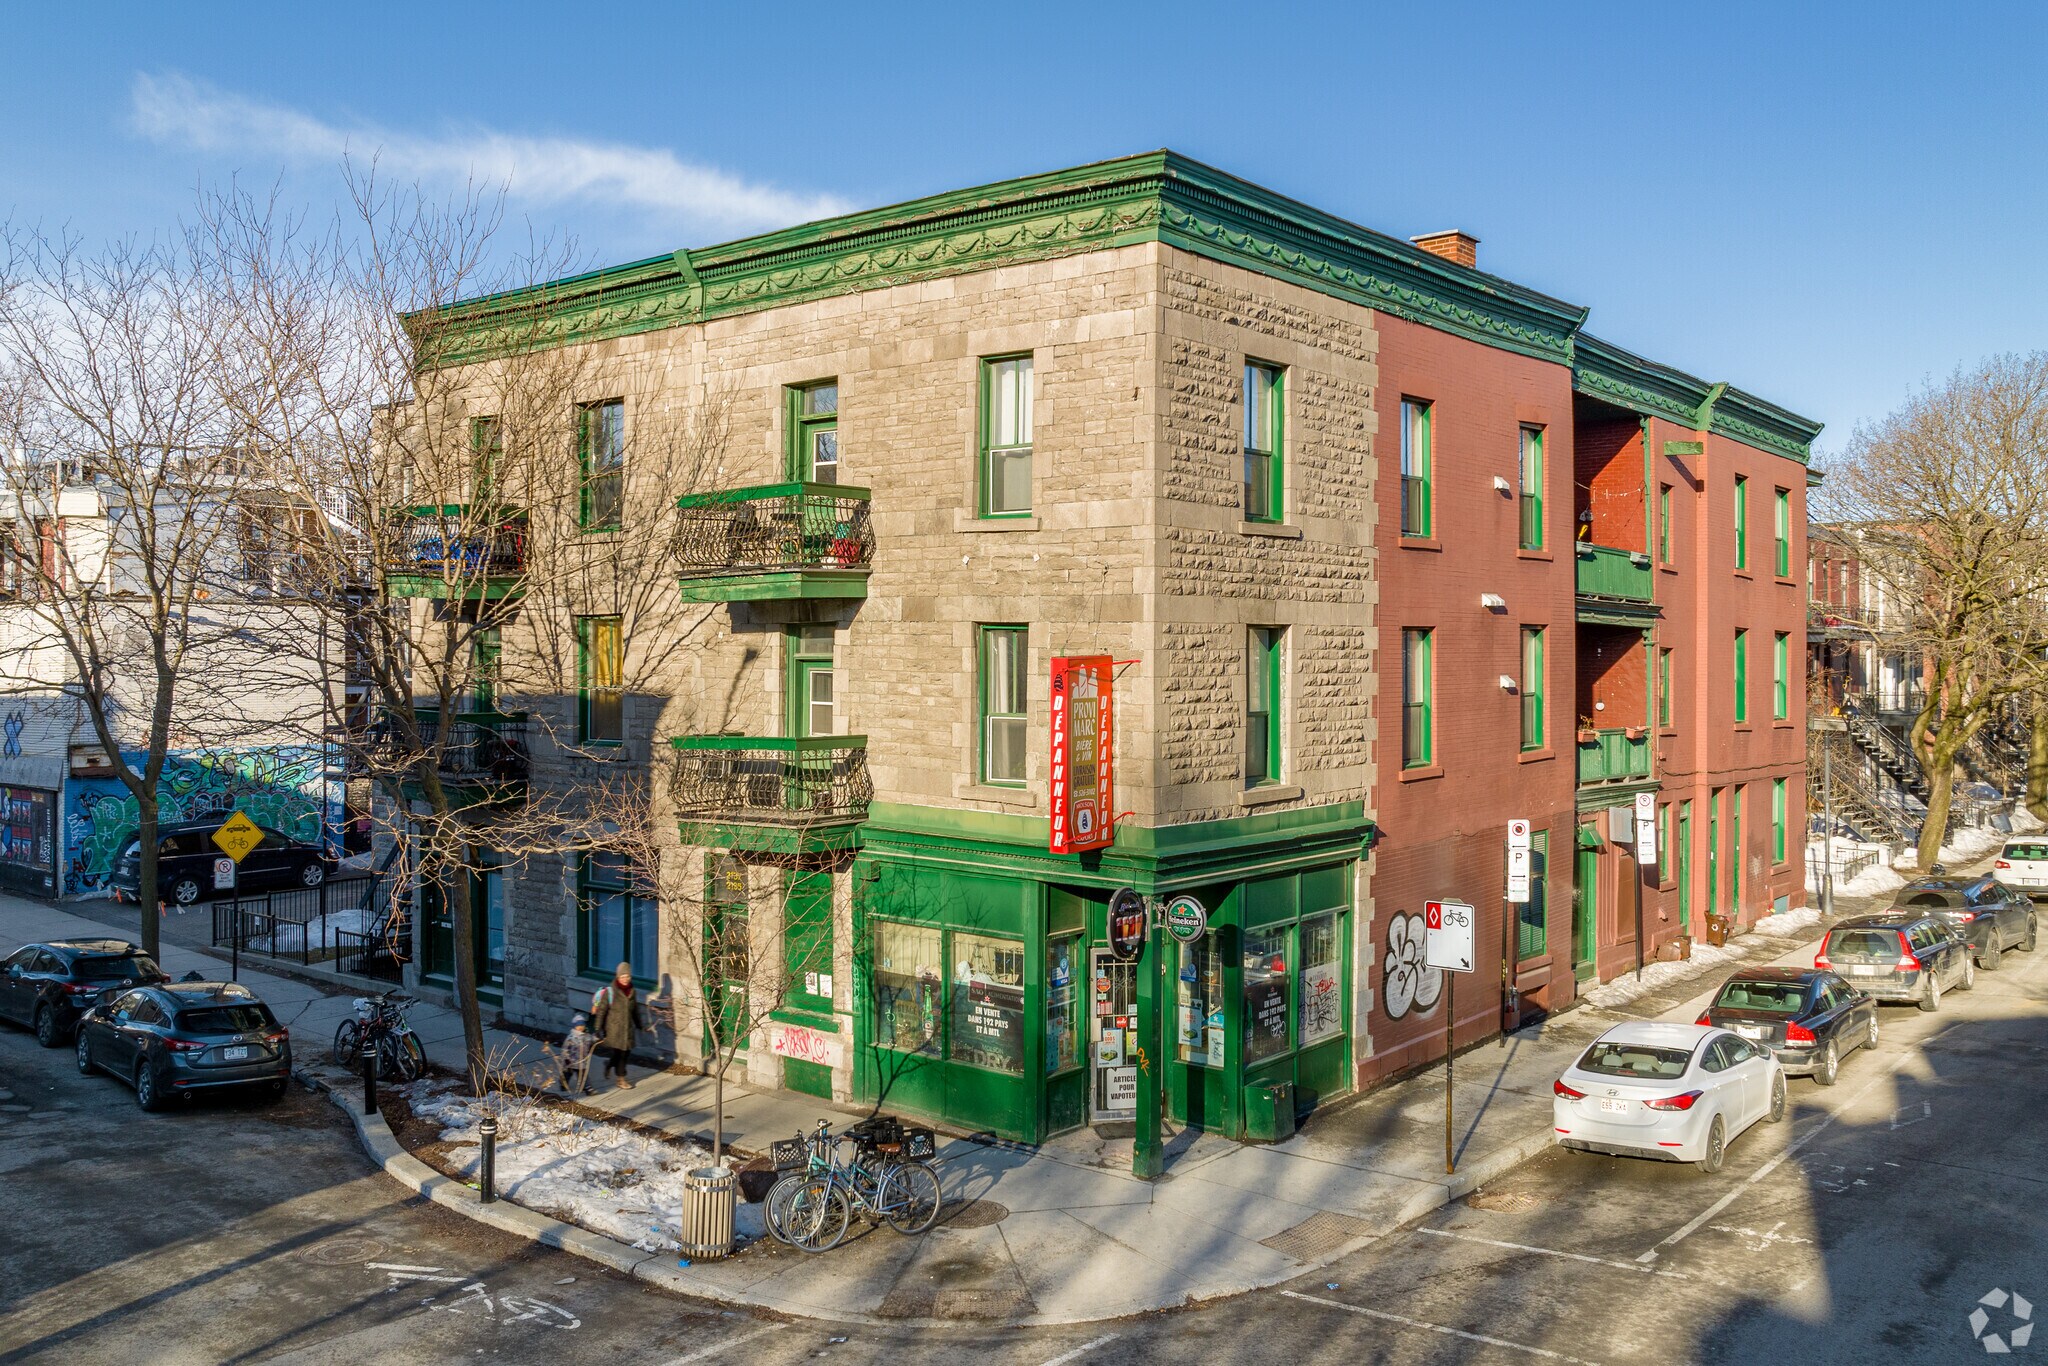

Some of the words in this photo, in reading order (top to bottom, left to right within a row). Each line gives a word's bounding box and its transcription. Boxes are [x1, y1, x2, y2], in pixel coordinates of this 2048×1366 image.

[1073, 701, 1096, 720] PROVI
[1073, 718, 1096, 737] MARC
[1075, 739, 1093, 751] BIÈRE
[1082, 750, 1093, 761] VIN
[1053, 695, 1064, 847] DÉPANNEUR
[1100, 695, 1108, 841] DÉPANNEUR
[1515, 852, 1523, 864] P
[1264, 1000, 1269, 1008] EN
[1270, 996, 1281, 1007] VENTE
[975, 1006, 983, 1015] EN
[983, 1008, 1000, 1018] VENTE
[1259, 1009, 1269, 1019] DANS
[1277, 1004, 1286, 1013] PAYS
[967, 1014, 982, 1024] DANS
[983, 1017, 994, 1026] 192
[994, 1019, 1009, 1029] PAYS
[975, 1025, 983, 1034] ET
[983, 1024, 988, 1035] À
[988, 1027, 1000, 1037] MTL
[973, 1048, 1012, 1070] DRY
[1113, 1075, 1137, 1083] ARTICLE
[1110, 1092, 1137, 1100] VAPOTEU
